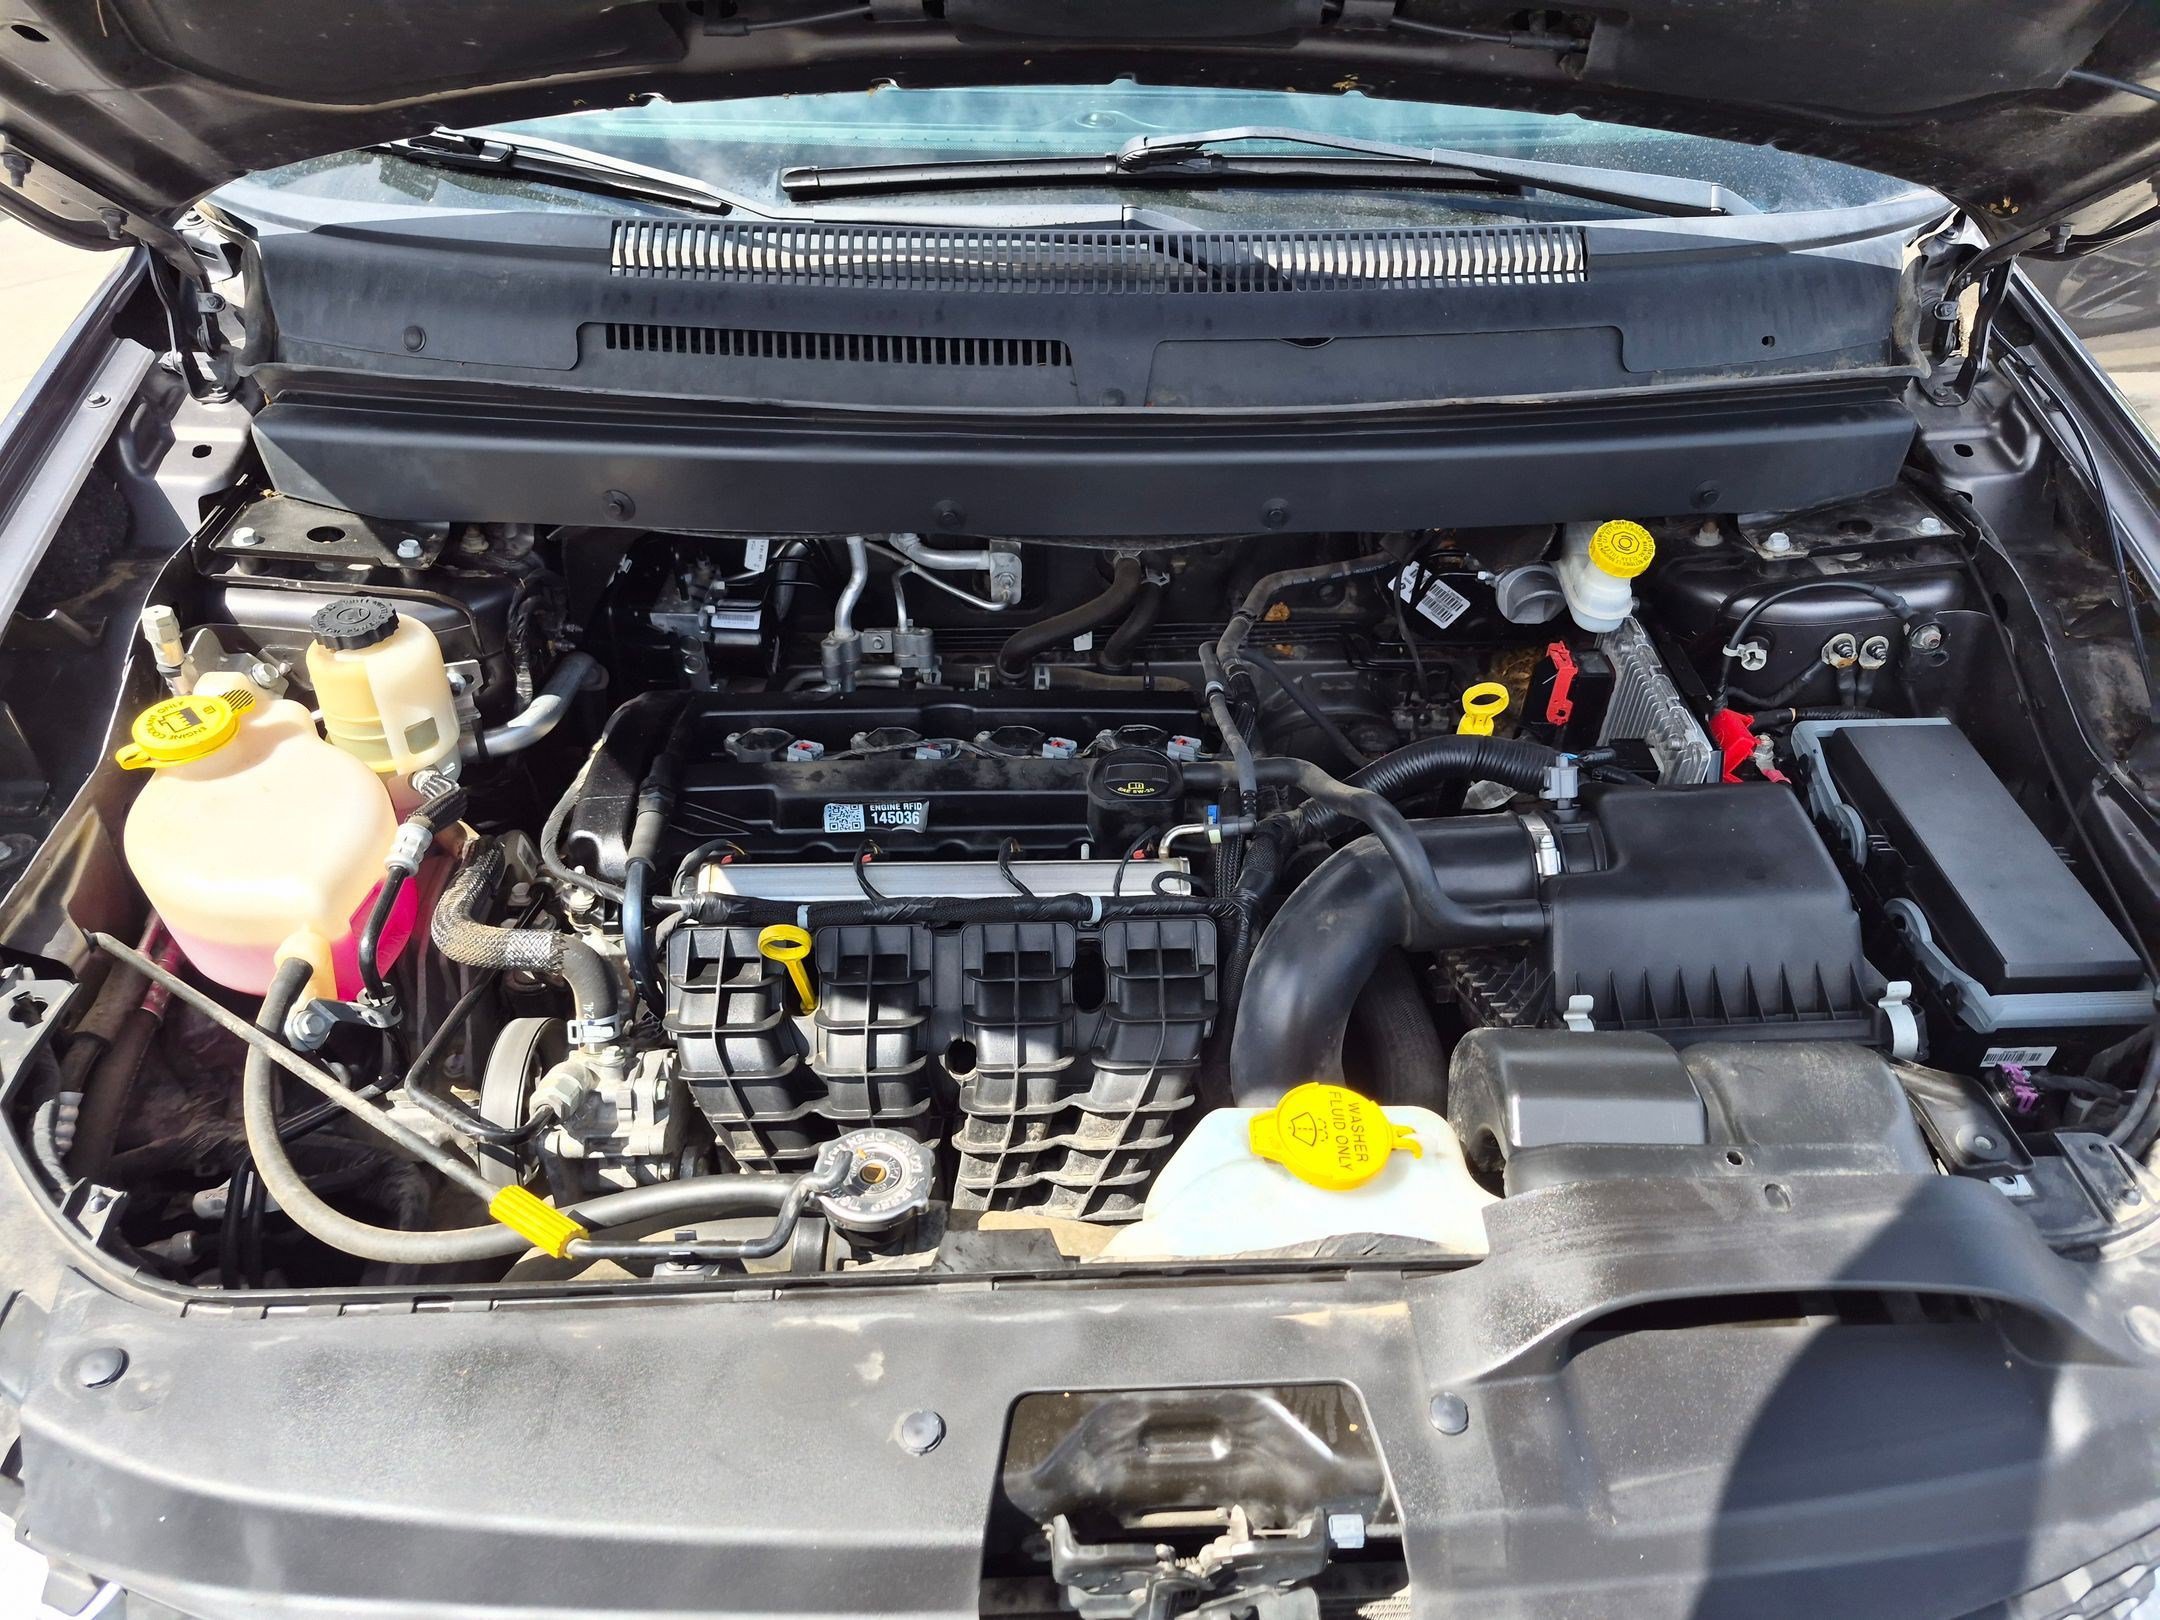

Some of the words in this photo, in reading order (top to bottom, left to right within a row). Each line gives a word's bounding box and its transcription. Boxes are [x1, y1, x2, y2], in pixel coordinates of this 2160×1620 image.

[157, 701, 185, 714] ONLY
[169, 726, 208, 740] ENGINE
[869, 803, 901, 812] ENGINE
[902, 802, 923, 811] RFID
[871, 811, 920, 825] 145036
[1328, 1091, 1347, 1131] FLUID
[1348, 1101, 1369, 1164] WASHER
[1335, 1135, 1354, 1172] ONLY
